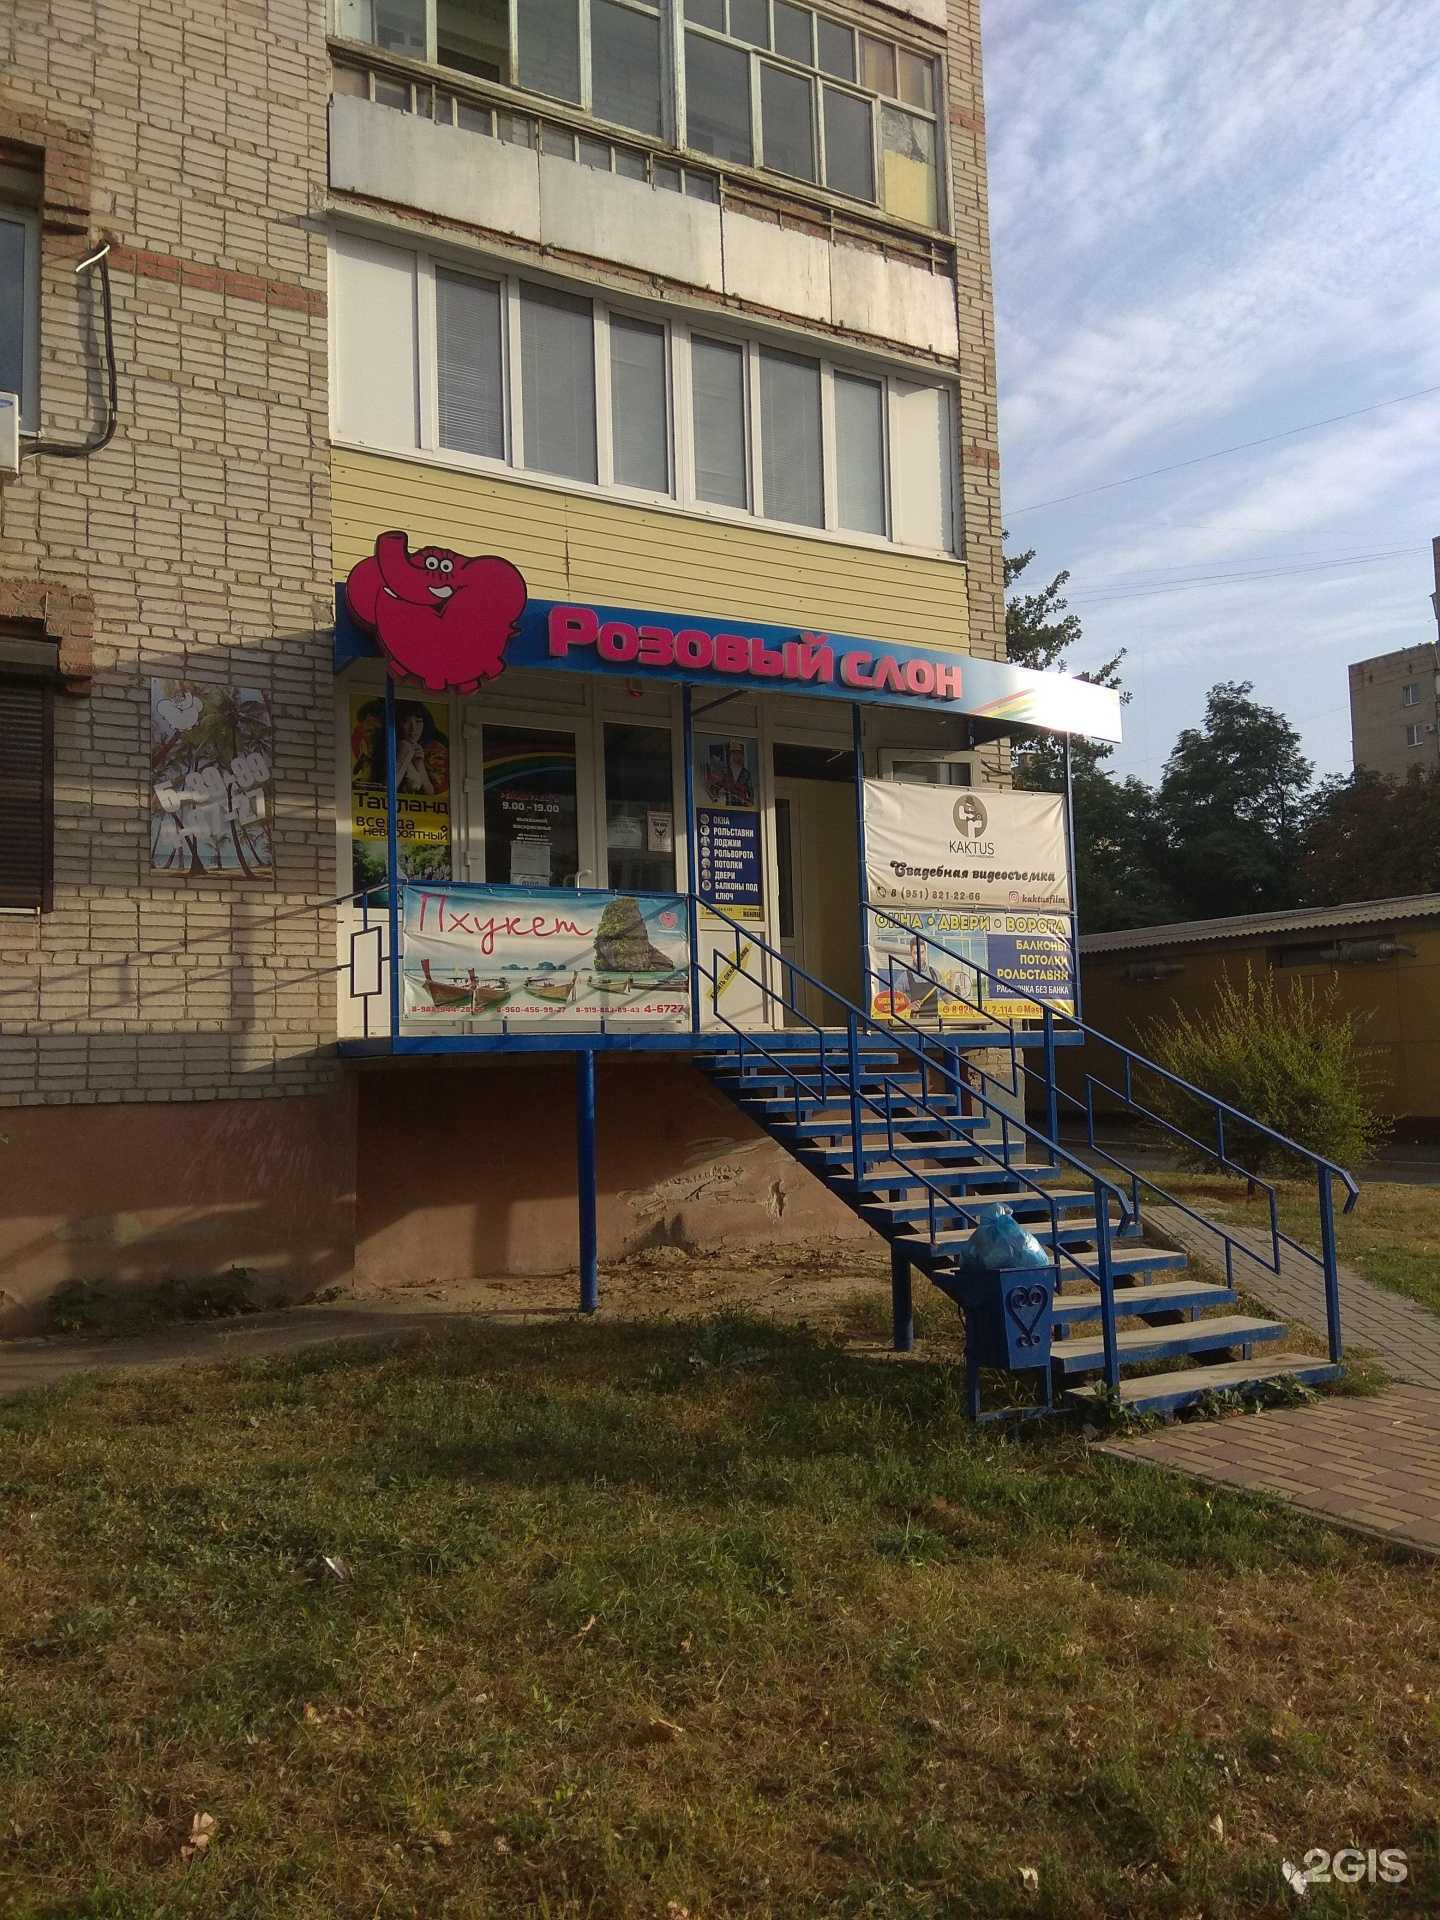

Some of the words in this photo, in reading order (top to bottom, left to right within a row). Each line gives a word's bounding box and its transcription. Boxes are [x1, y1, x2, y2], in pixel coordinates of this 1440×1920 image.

[356, 816, 415, 830] вседа
[713, 816, 730, 825] ОКНА
[713, 827, 754, 838] РОЛЬСТАВНИ
[714, 838, 741, 849] ЛОДЖИИ
[949, 840, 995, 855] KAKTUS
[714, 849, 754, 860] РОЛЬВОРОТА
[714, 860, 743, 870] ПОТОЛКИ
[714, 871, 736, 881] ДВЕРИ
[889, 860, 969, 881] Свадебная
[972, 870, 1056, 884] видеосъемка
[715, 882, 745, 892] БАЛКОНЫ
[746, 883, 758, 893] ПОД
[715, 892, 734, 901] КЛЮЧ
[890, 888, 897, 898] 8
[901, 886, 929, 901] (951)
[1022, 893, 1067, 905] kaktusfilm
[419, 894, 594, 956] Пхукет
[938, 914, 991, 931] ДВЕРИ
[1005, 917, 1067, 935] ВОРОТА
[1016, 940, 1067, 952] БАЛКОНЫ
[1020, 955, 1068, 966] ПОТОЛКИ
[997, 969, 1069, 981] РОЛЬСТАВНИ
[1035, 986, 1048, 994] БЕЗ
[1048, 986, 1069, 995] БАНКА
[644, 1004, 685, 1014] 4-6727
